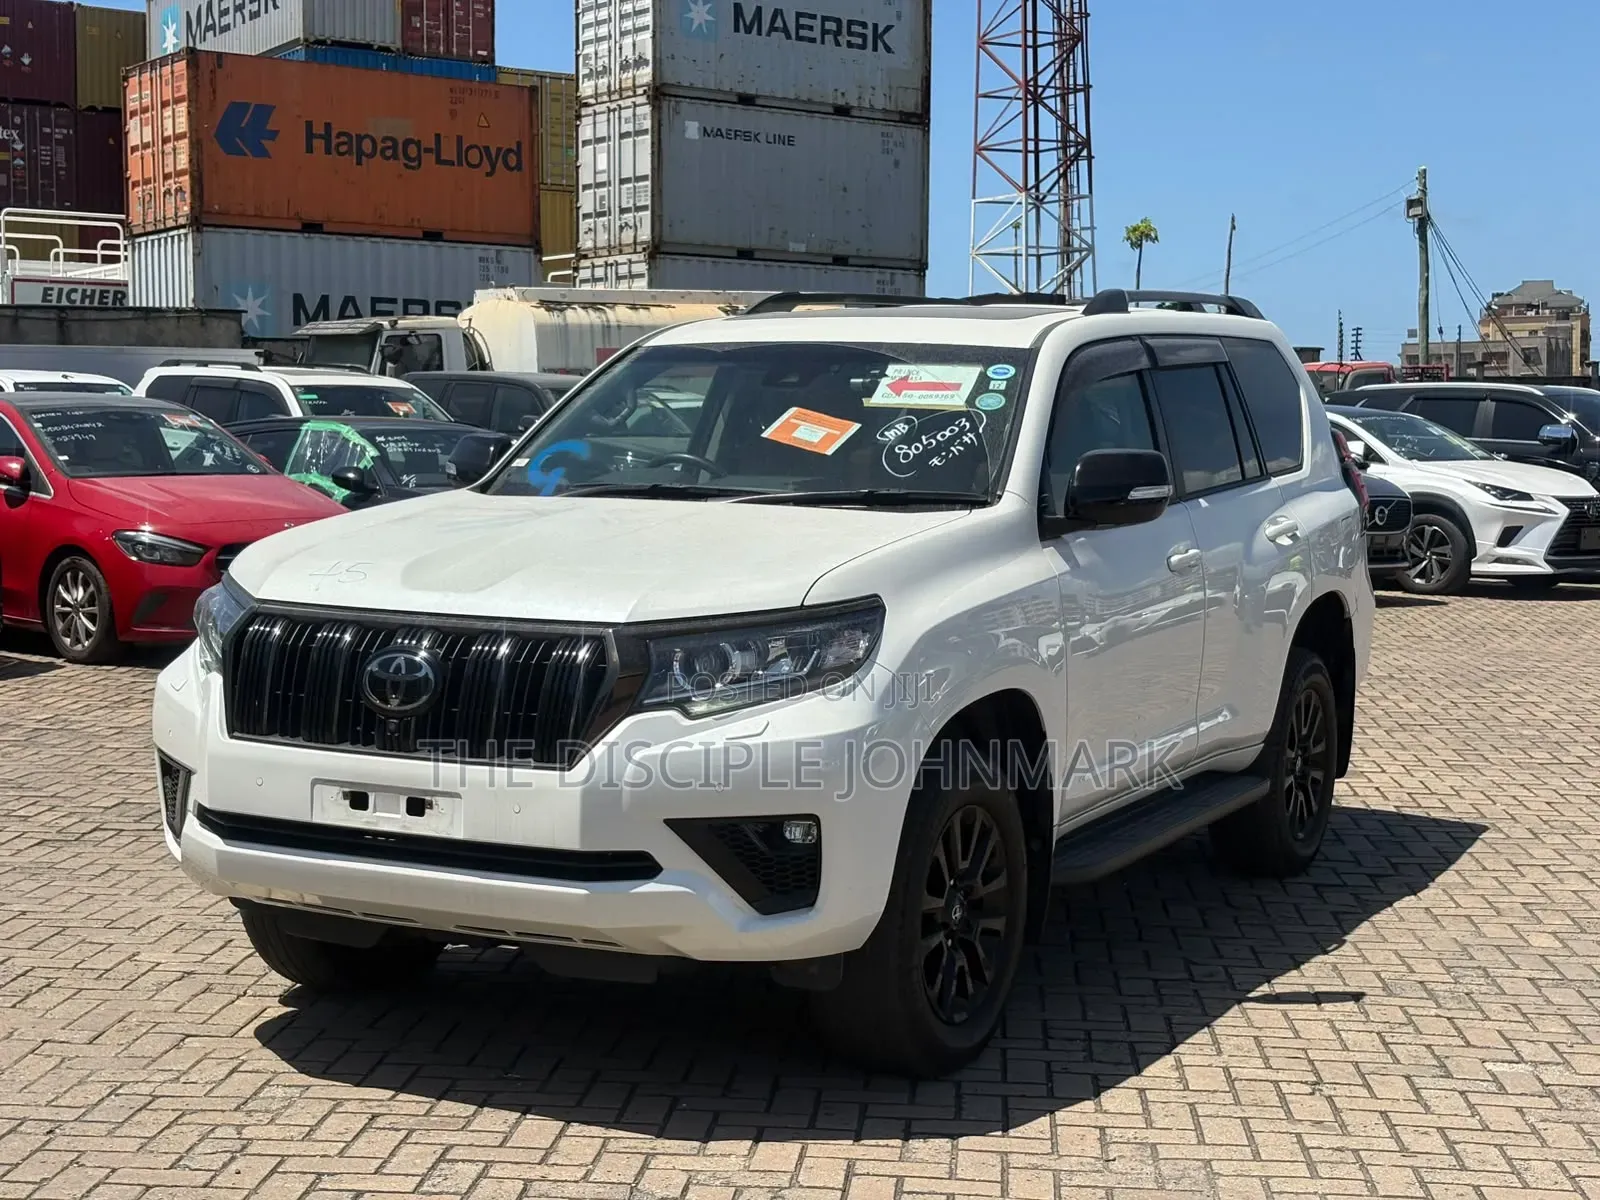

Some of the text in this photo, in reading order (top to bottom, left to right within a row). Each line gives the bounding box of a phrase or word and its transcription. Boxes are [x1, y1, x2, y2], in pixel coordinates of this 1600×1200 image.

[732, 2, 896, 54] MAERSK
[304, 120, 523, 177] Hapag-Lloyd
[702, 126, 796, 147] MAERSK LINE
[41, 286, 126, 306] EICHER
[884, 422, 909, 441] MB
[895, 417, 970, 464] 805003
